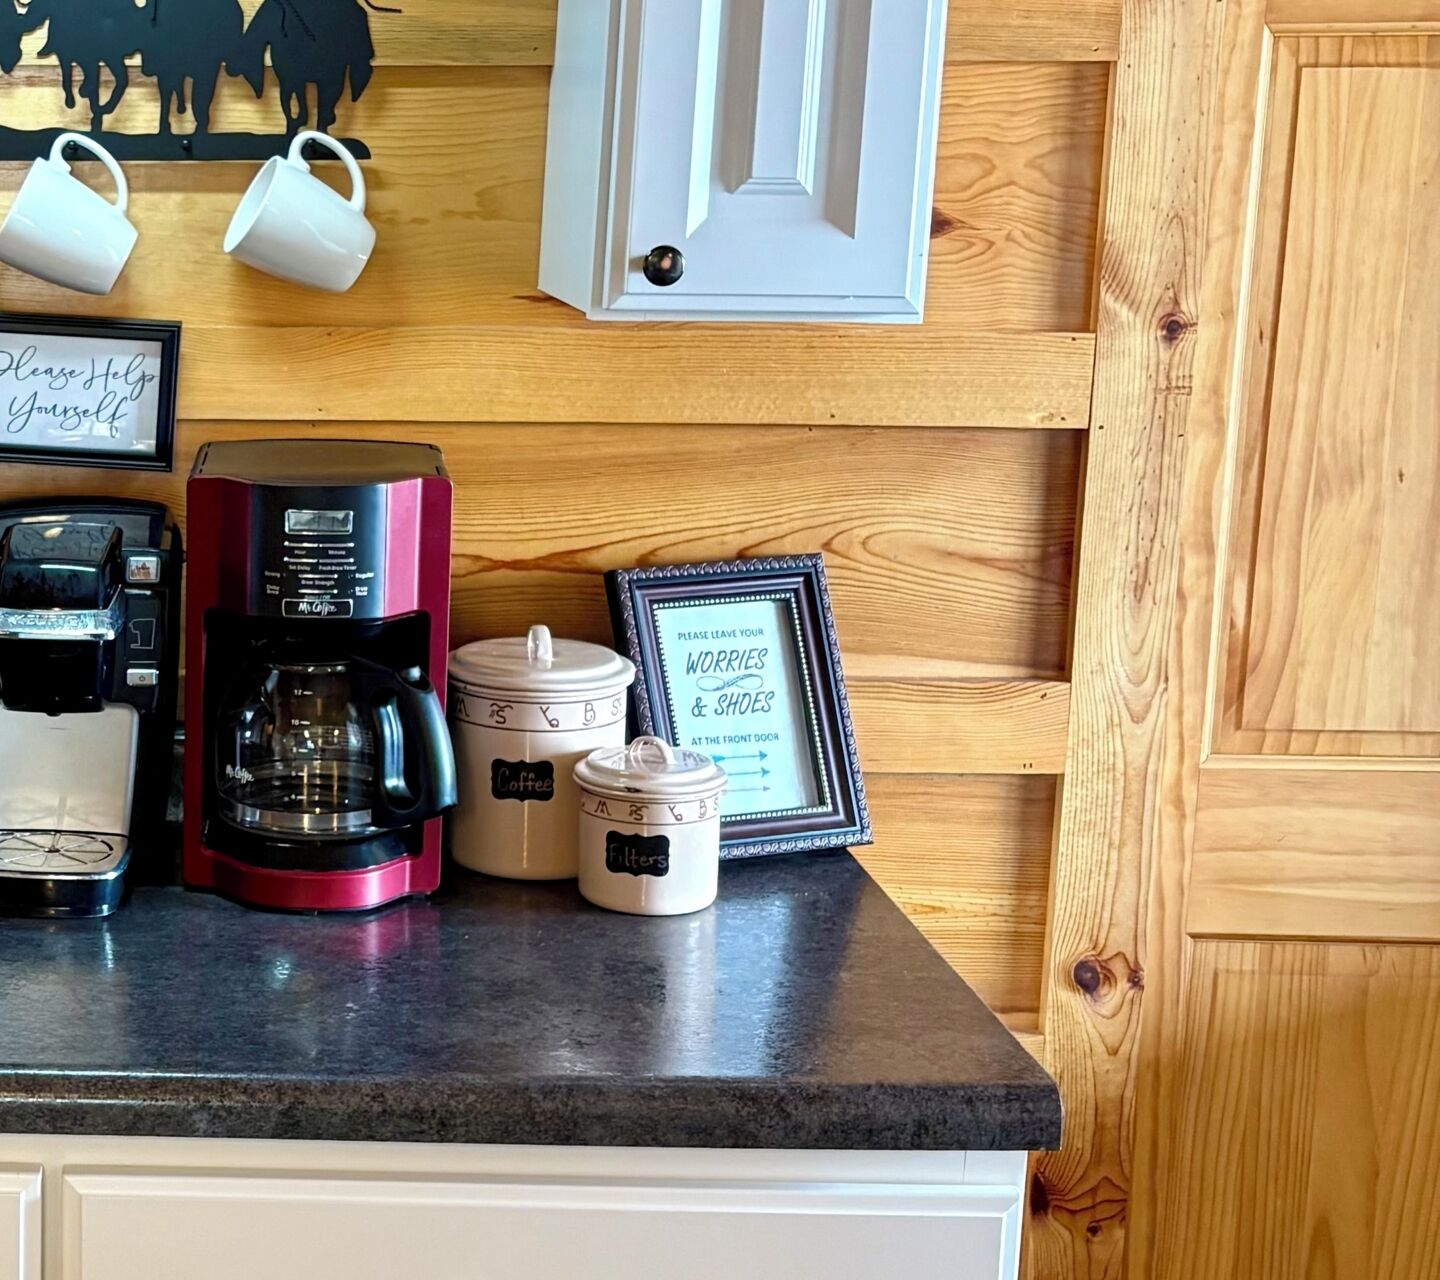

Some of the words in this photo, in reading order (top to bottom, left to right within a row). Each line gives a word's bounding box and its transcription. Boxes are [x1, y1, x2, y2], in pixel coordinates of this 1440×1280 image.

[83, 353, 157, 401] Help
[7, 391, 129, 439] Yourself
[312, 602, 336, 616] Coffee
[678, 630, 709, 641] PLEASE
[711, 629, 737, 639] LEAVE
[739, 628, 764, 638] YOUR
[686, 647, 768, 675] WORRIES
[691, 696, 708, 717] &
[714, 690, 775, 716] SHOES
[691, 737, 702, 746] AT
[705, 735, 721, 745] THE
[723, 734, 752, 744] FRONT
[754, 732, 779, 743] DOOR
[497, 767, 553, 793] Coffee
[609, 843, 668, 868] Filters
